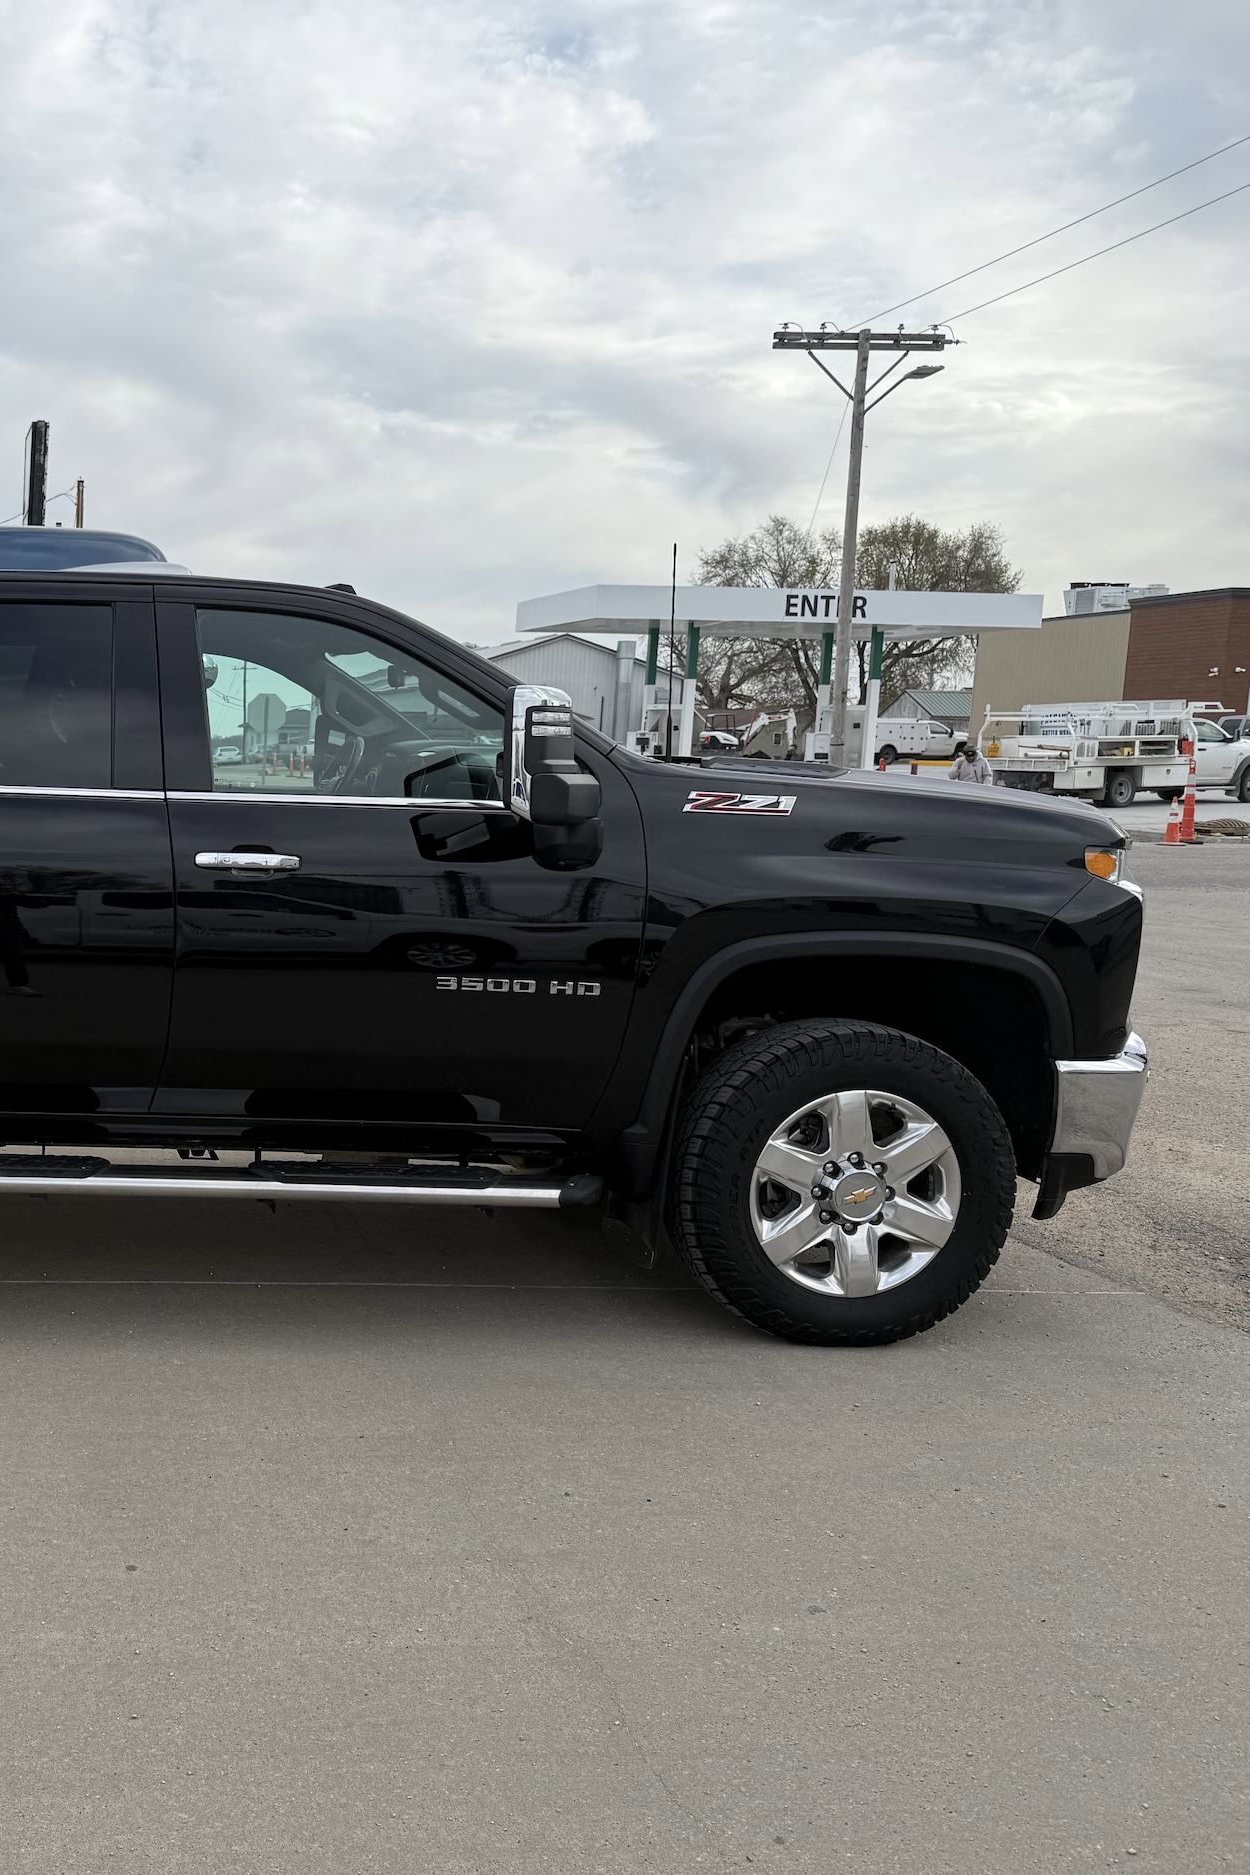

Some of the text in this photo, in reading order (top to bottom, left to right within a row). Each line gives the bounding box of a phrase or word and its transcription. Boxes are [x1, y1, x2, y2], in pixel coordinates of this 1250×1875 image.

[785, 594, 868, 619] ENTR
[682, 790, 797, 816] Z71
[436, 976, 601, 996] 3500 HD
[739, 1118, 765, 1161] ATP
